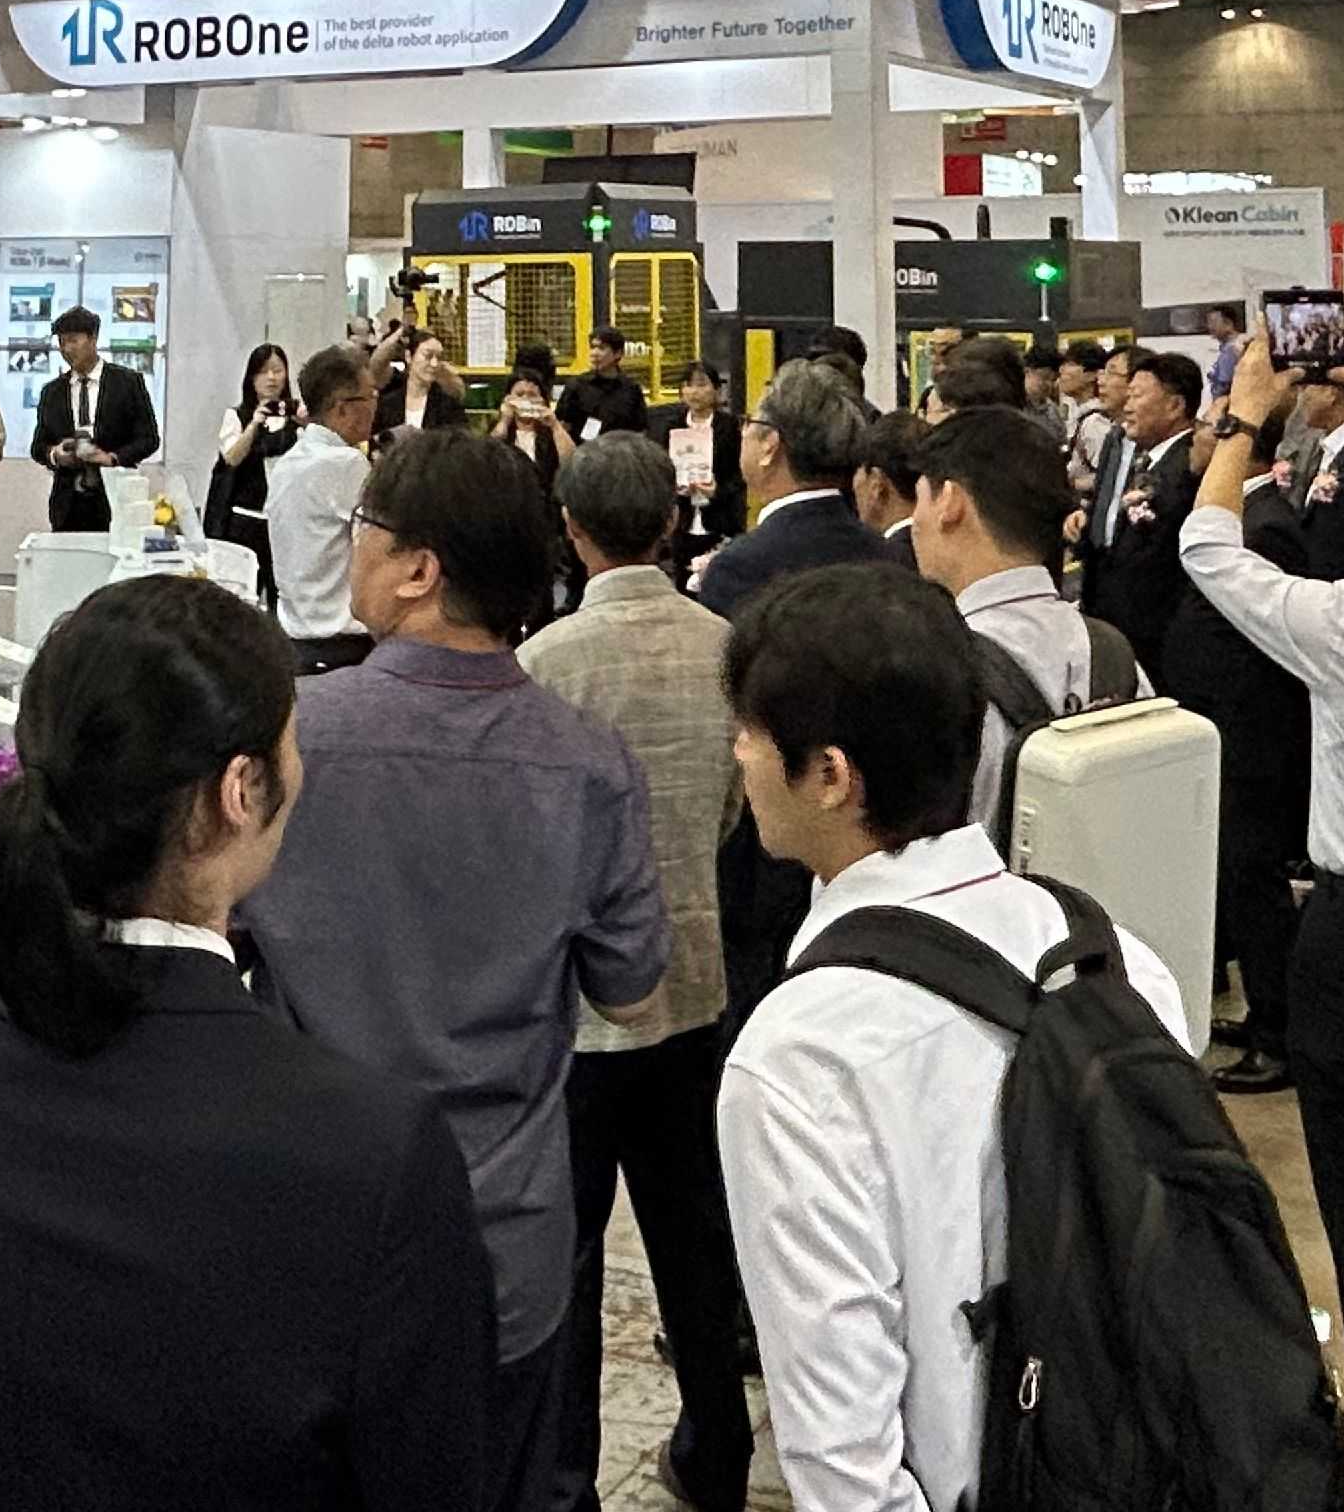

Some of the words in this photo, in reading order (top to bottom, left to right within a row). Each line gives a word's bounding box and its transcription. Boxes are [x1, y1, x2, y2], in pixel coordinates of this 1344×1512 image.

[324, 17, 348, 33] The
[350, 15, 376, 32] best
[379, 13, 435, 32] provider
[635, 24, 706, 44] Brighter
[711, 20, 769, 39] Future
[774, 15, 855, 36] Together
[1041, 0, 1097, 50] ROBOne
[134, 13, 310, 63] ROBOne
[324, 35, 336, 51] of
[339, 34, 360, 50] the
[362, 33, 394, 50] delta
[397, 31, 433, 47] robot
[435, 28, 510, 49] application
[1182, 205, 1239, 224] Klean
[1241, 204, 1299, 223] Cabin
[895, 268, 939, 286] OBin
